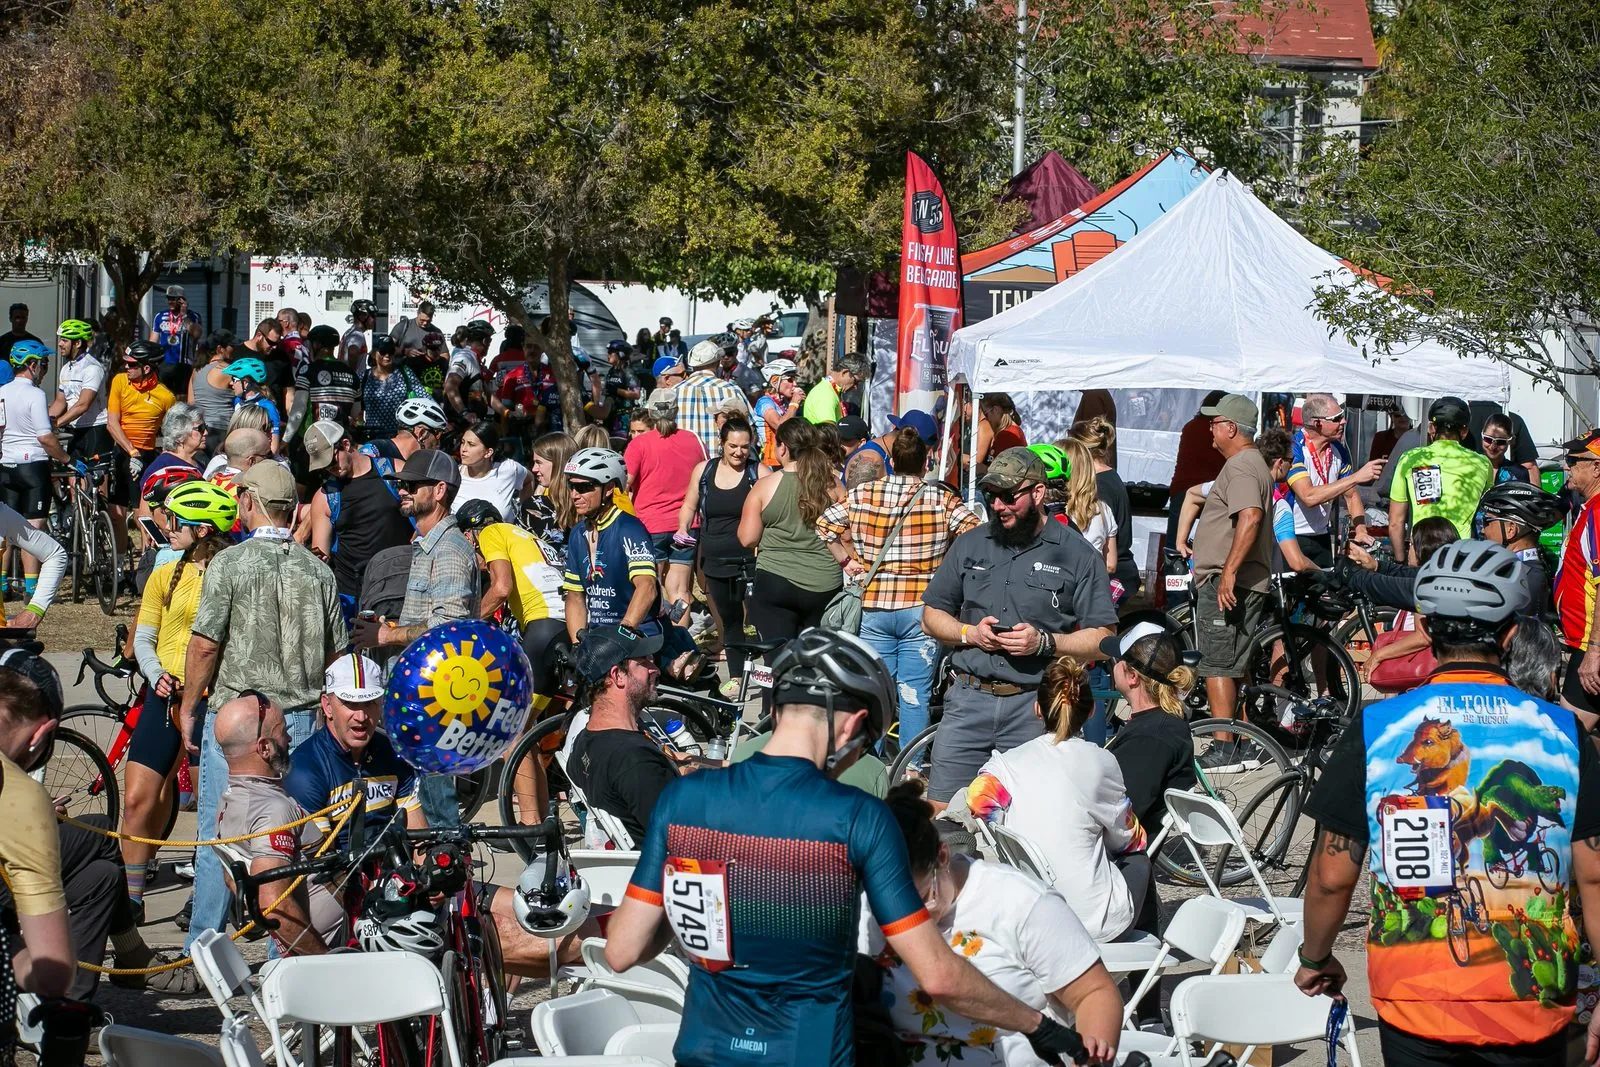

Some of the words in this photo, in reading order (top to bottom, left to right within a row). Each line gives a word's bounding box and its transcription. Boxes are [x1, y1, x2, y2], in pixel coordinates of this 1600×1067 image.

[929, 202, 943, 226] 55
[936, 246, 955, 266] LINE
[256, 283, 273, 292] 150
[925, 268, 958, 289] GARDE
[932, 374, 942, 384] IPA
[1416, 471, 1433, 499] 2363
[1167, 578, 1183, 588] 6957
[1434, 585, 1472, 594] OAKLEY
[340, 692, 356, 700] EDDY
[1437, 695, 1459, 714] EL
[1461, 694, 1509, 715] TOUR
[1462, 714, 1475, 724] DE
[1477, 714, 1509, 725] TUCSON
[1394, 816, 1431, 880] 2108
[1440, 849, 1449, 874] 102-MILE
[672, 879, 709, 951] 5749
[715, 918, 725, 942] 57-MILE
